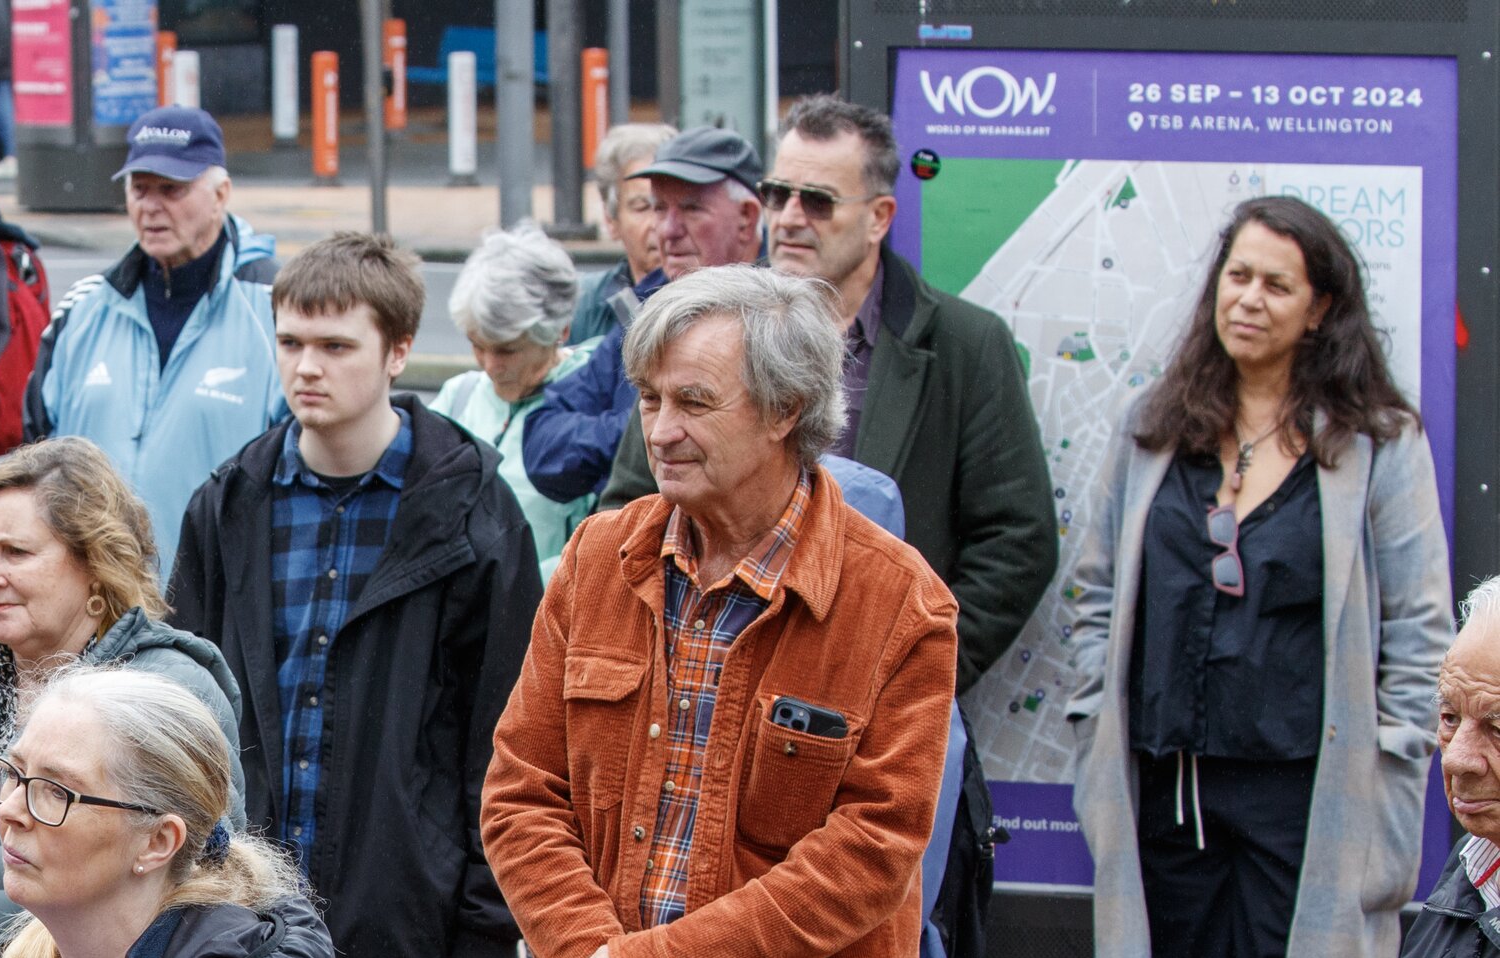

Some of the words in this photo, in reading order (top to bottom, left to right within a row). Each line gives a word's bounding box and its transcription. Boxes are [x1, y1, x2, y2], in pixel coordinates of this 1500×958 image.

[920, 66, 1057, 118] WOW
[1129, 83, 1162, 103] 26
[1169, 84, 1221, 103] SEP
[1251, 85, 1280, 104] 13
[1288, 86, 1345, 106] OCT
[1351, 87, 1423, 107] 2024
[926, 124, 961, 135] WORLD
[962, 125, 977, 135] OF
[1149, 114, 1184, 130] TSB
[1190, 115, 1260, 132] ARENA,
[1266, 116, 1393, 134] WELLINGTON
[1022, 818, 1048, 831] out
[1050, 821, 1081, 833] mor
